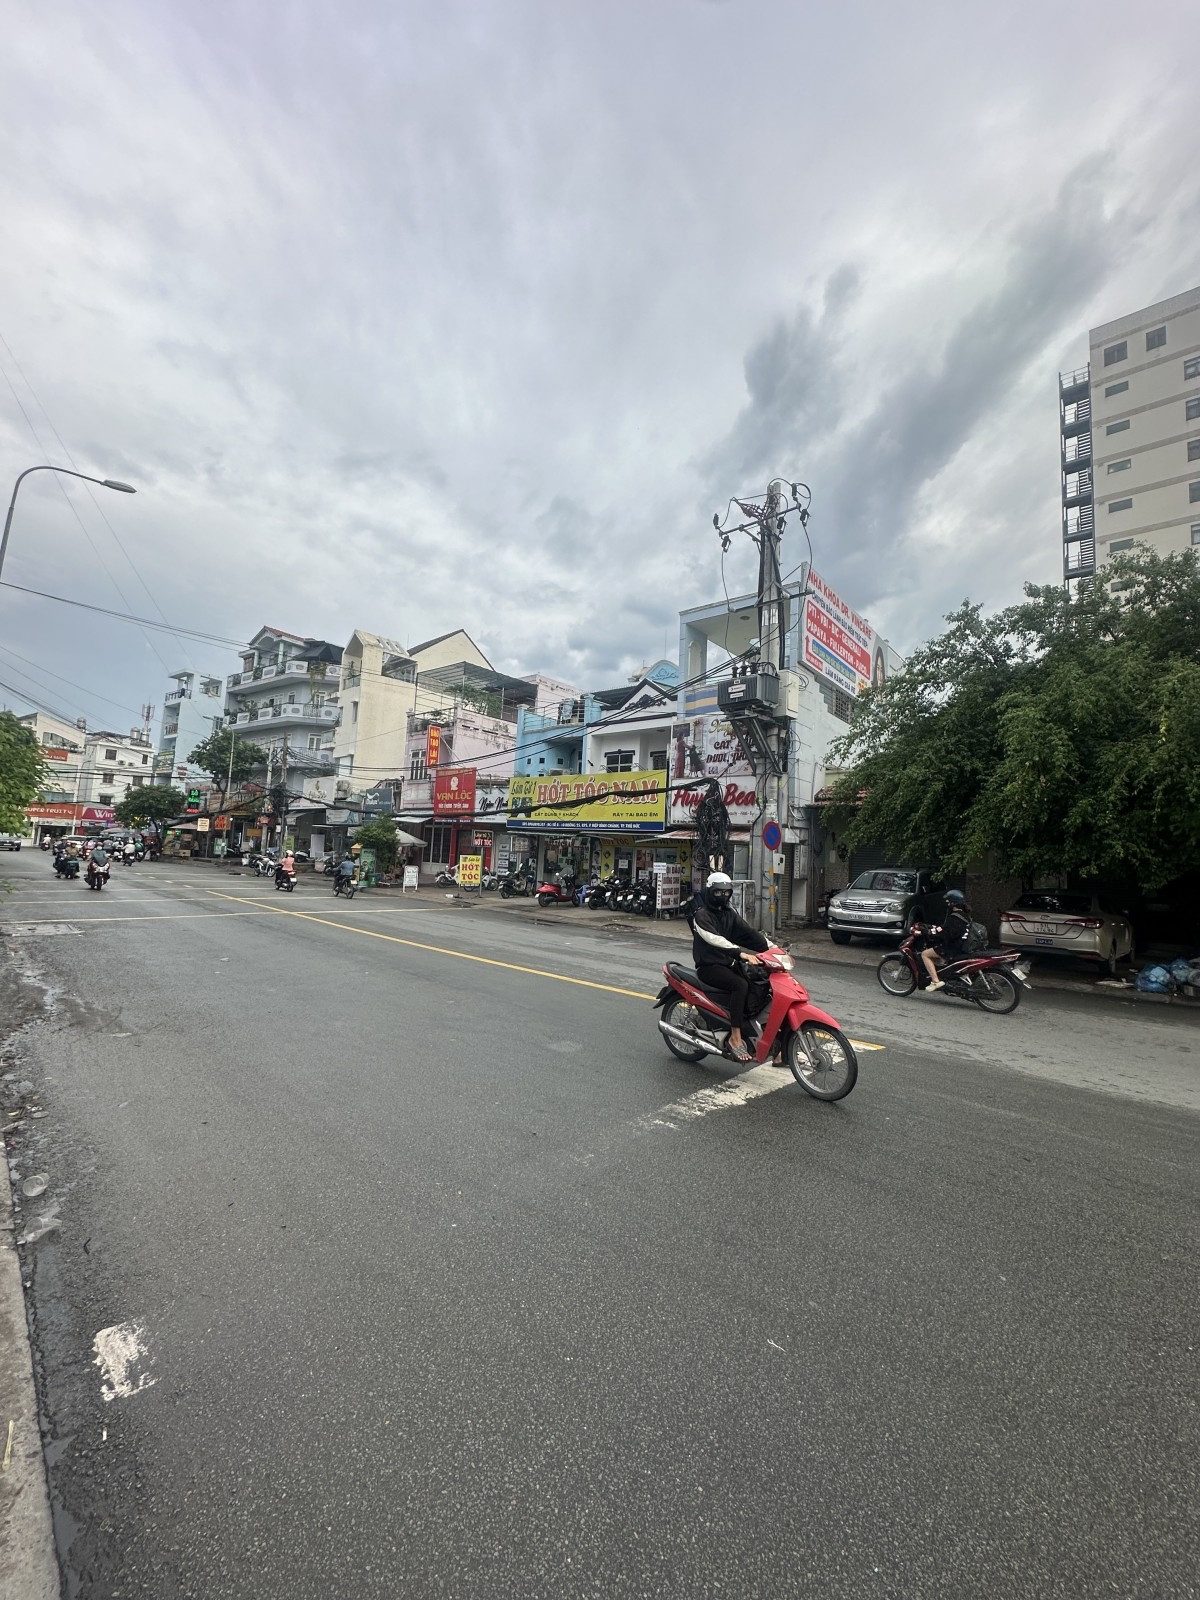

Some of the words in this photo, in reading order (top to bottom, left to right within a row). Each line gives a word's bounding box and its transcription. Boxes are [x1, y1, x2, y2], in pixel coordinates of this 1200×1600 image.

[808, 569, 822, 592] NHA
[823, 583, 840, 609] KHOA
[537, 779, 570, 804] HỚT
[574, 776, 608, 805] TÓC
[612, 779, 659, 804] NAM
[461, 871, 479, 880] TÓC
[462, 862, 480, 871] HỚT
